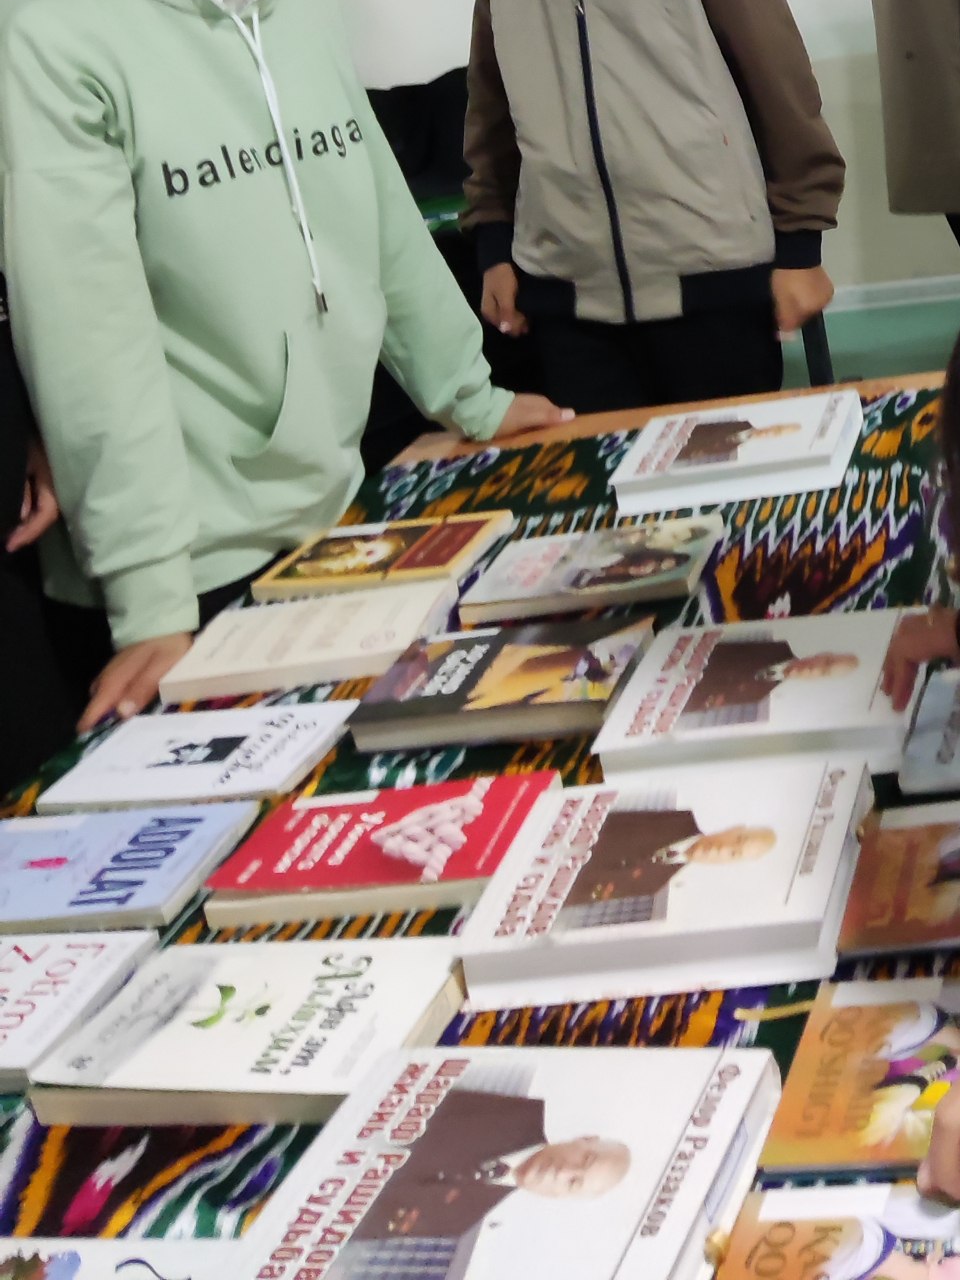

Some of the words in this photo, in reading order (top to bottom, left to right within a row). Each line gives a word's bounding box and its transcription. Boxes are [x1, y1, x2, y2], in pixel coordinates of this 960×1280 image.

[69, 817, 205, 907] ADOLAT
[0, 942, 106, 1045] Fotim
[256, 1179, 347, 1278] судьба
